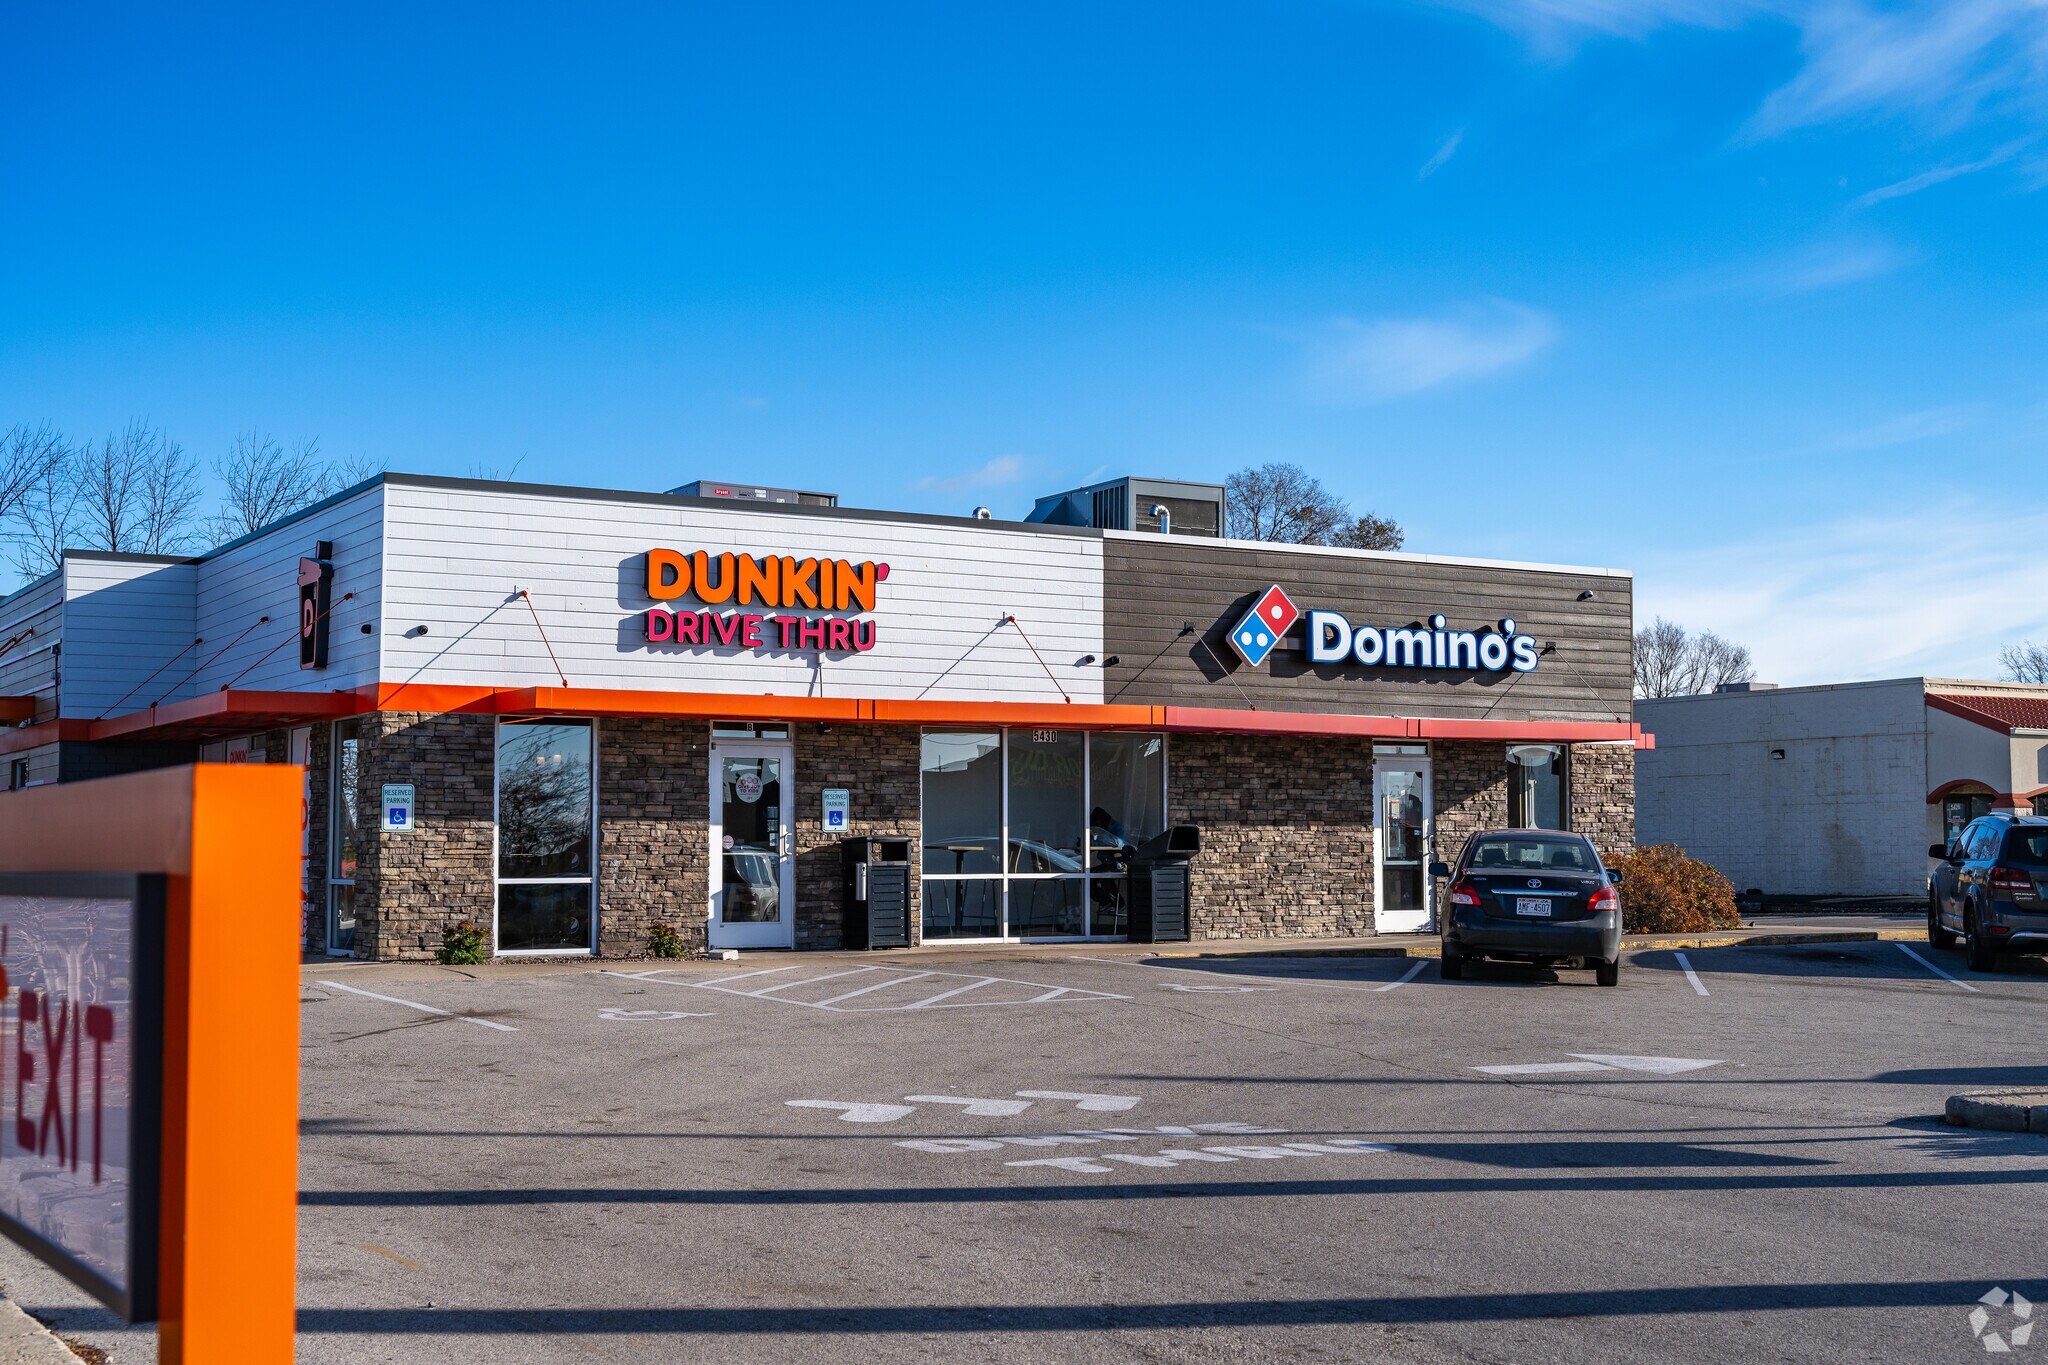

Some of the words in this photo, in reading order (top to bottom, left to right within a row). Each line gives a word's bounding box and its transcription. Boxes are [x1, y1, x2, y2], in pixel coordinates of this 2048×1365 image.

[645, 548, 890, 612] DUNKIN'
[646, 609, 764, 648] DRIVE
[774, 615, 876, 652] THRU
[1306, 609, 1539, 673] Domino's
[747, 723, 753, 732] B
[1033, 730, 1057, 742] 5430
[17, 989, 115, 1185] EXIT
[891, 1122, 1291, 1153] DRIVE
[1003, 1139, 1398, 1173] THRU
